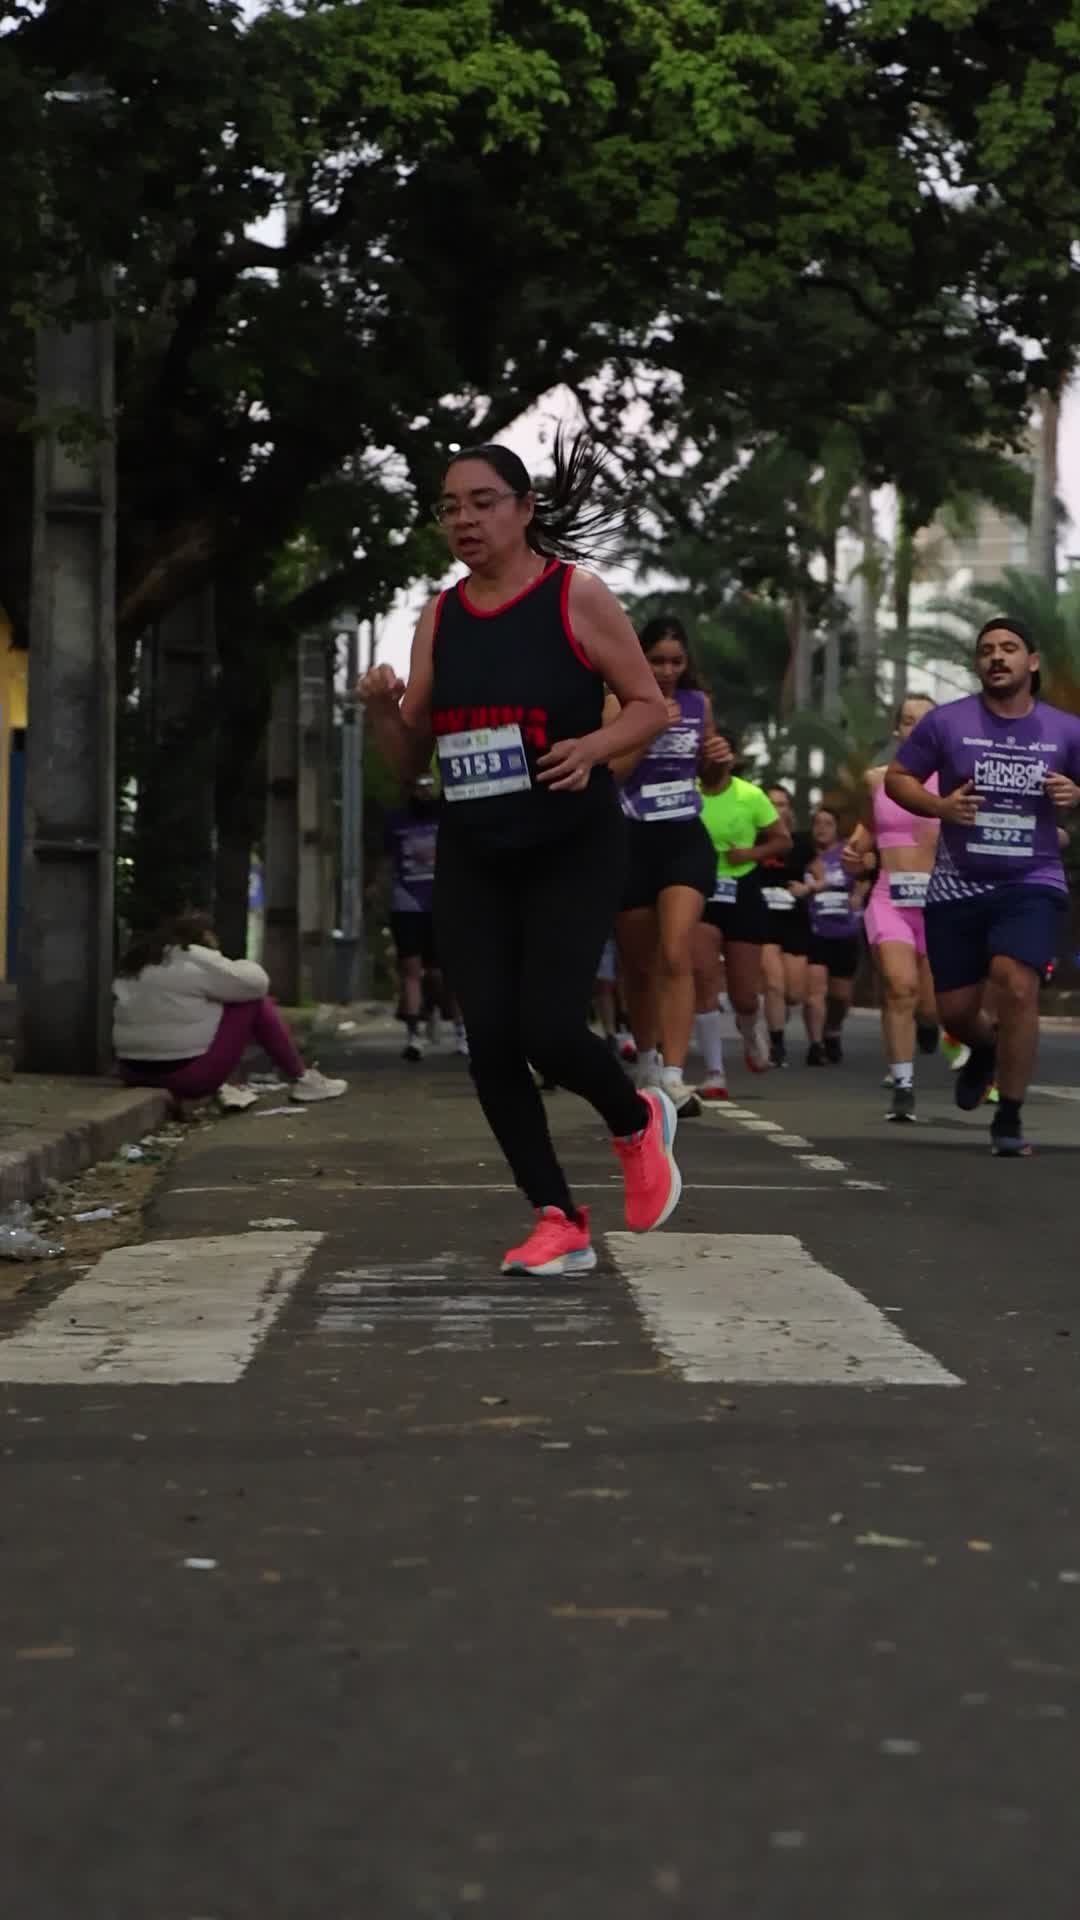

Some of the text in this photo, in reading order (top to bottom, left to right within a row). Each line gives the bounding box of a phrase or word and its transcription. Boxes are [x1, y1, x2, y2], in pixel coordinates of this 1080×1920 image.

[451, 752, 501, 778] 5153
[974, 760, 1038, 777] MUNDO
[982, 828, 1021, 842] 5672
